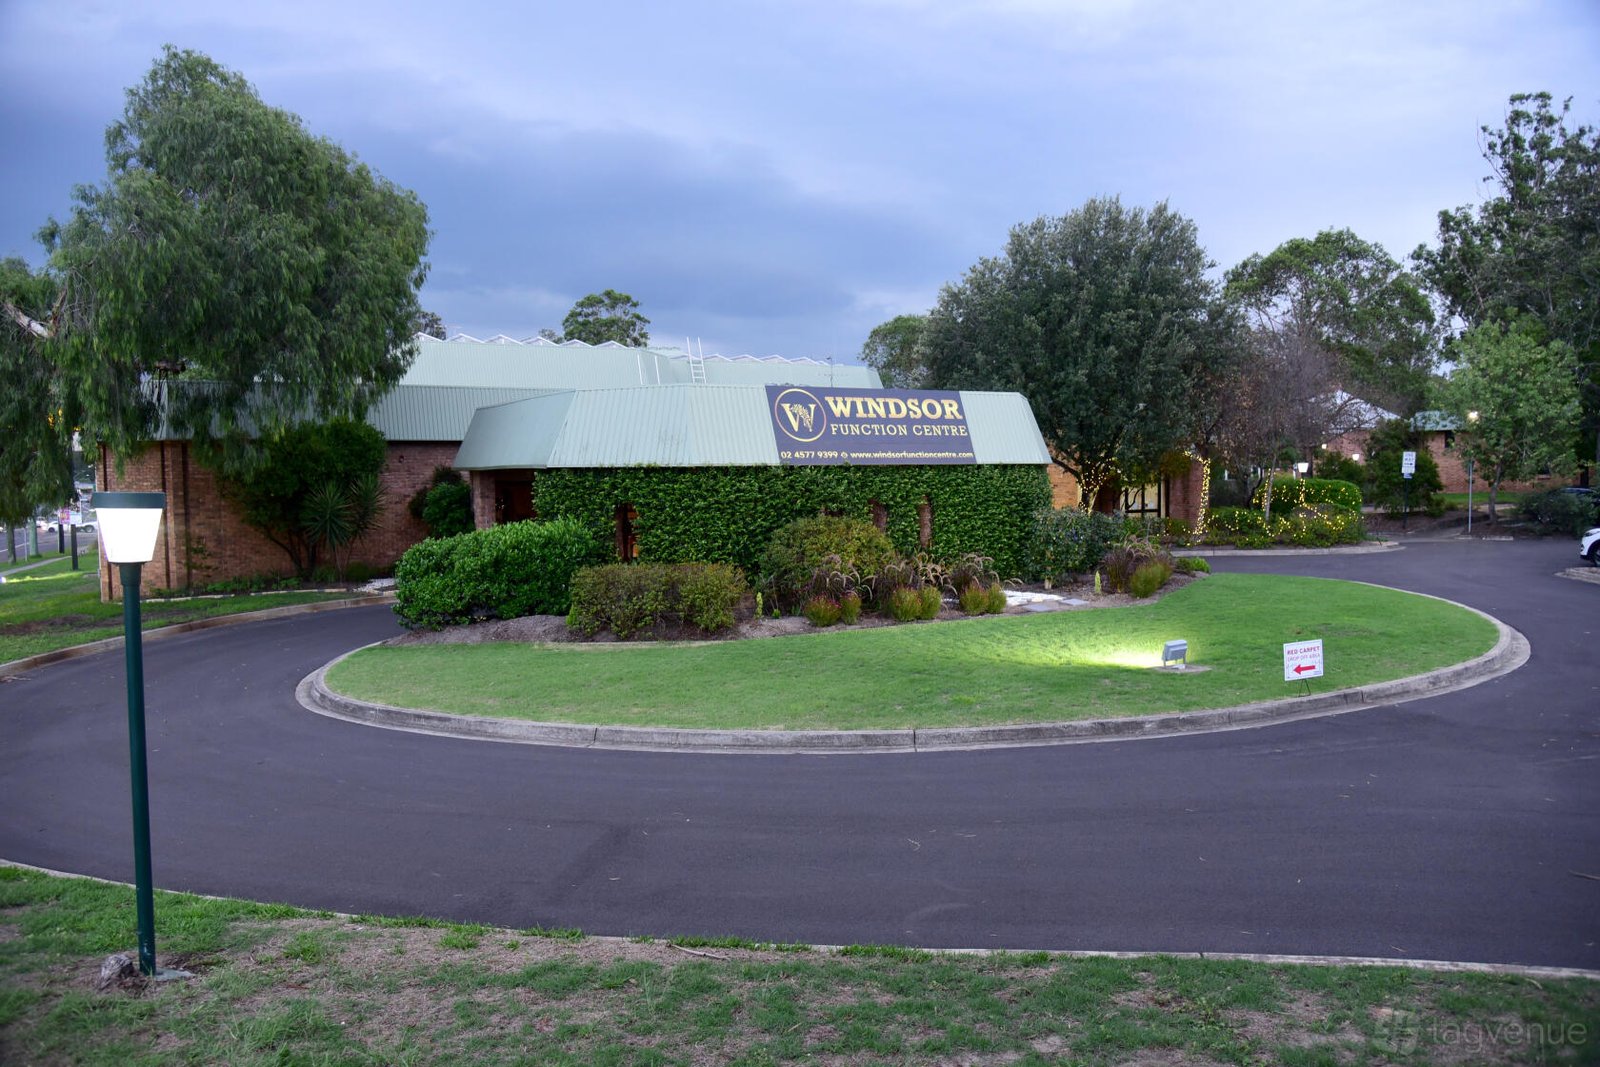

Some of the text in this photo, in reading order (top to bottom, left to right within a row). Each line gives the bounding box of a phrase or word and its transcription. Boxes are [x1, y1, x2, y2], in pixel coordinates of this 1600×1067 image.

[825, 396, 963, 420] WINDSOR
[831, 424, 968, 437] FUNCTION CENTRE
[781, 451, 973, 459] 02 4577 9399 www.windsorfunctioncentre.com
[1299, 645, 1321, 654] CARPET
